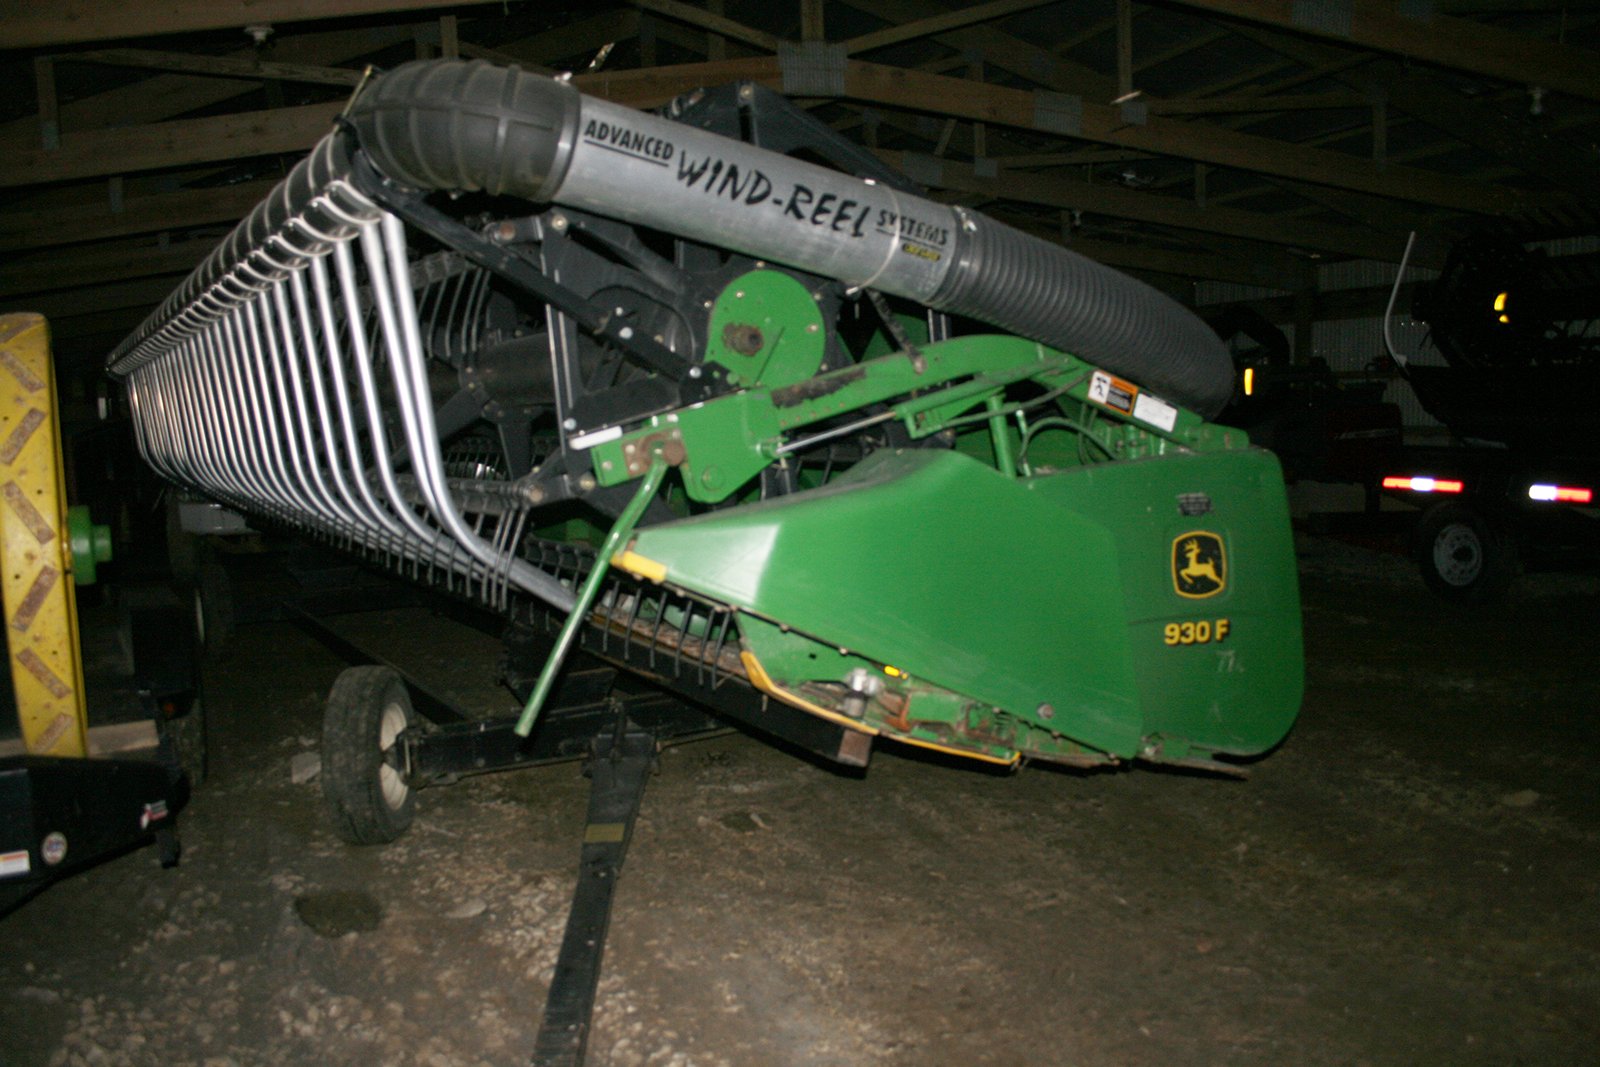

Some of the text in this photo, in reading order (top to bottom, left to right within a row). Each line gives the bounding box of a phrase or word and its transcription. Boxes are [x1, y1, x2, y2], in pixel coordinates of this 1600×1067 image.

[585, 119, 948, 246] ADVANCED WIND-REEL SYSTEMS
[1164, 618, 1230, 645] 930 F
